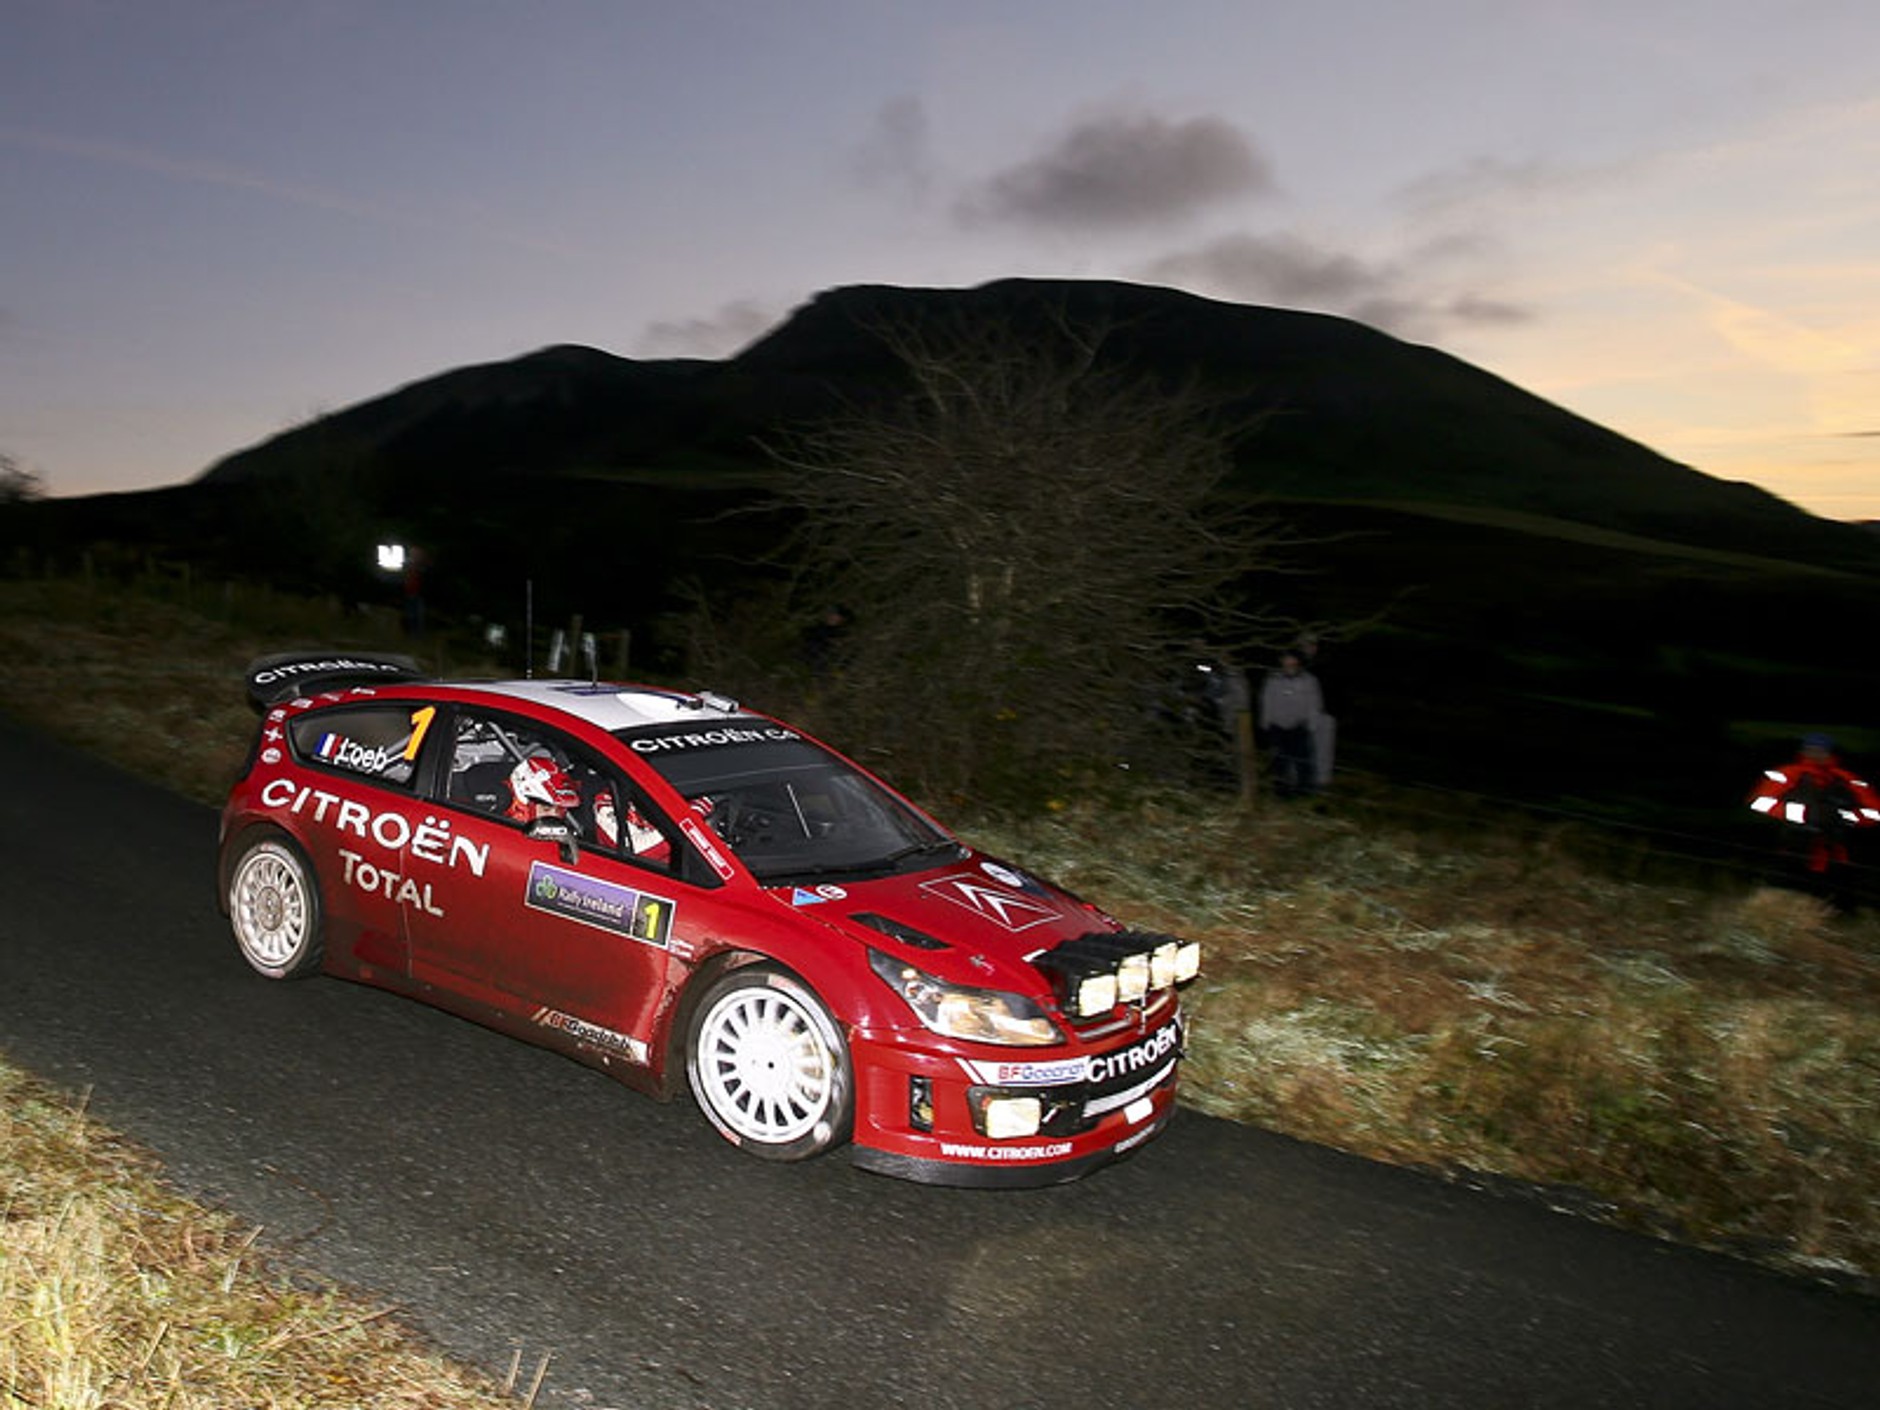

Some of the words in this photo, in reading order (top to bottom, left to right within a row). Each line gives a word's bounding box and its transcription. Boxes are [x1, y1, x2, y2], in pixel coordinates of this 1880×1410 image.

[404, 706, 435, 760] 1
[631, 728, 765, 753] CITROËN
[261, 778, 489, 877] CITROËN
[338, 849, 444, 917] TOTAL
[643, 901, 661, 939] 1
[1087, 1025, 1176, 1082] CITROËN
